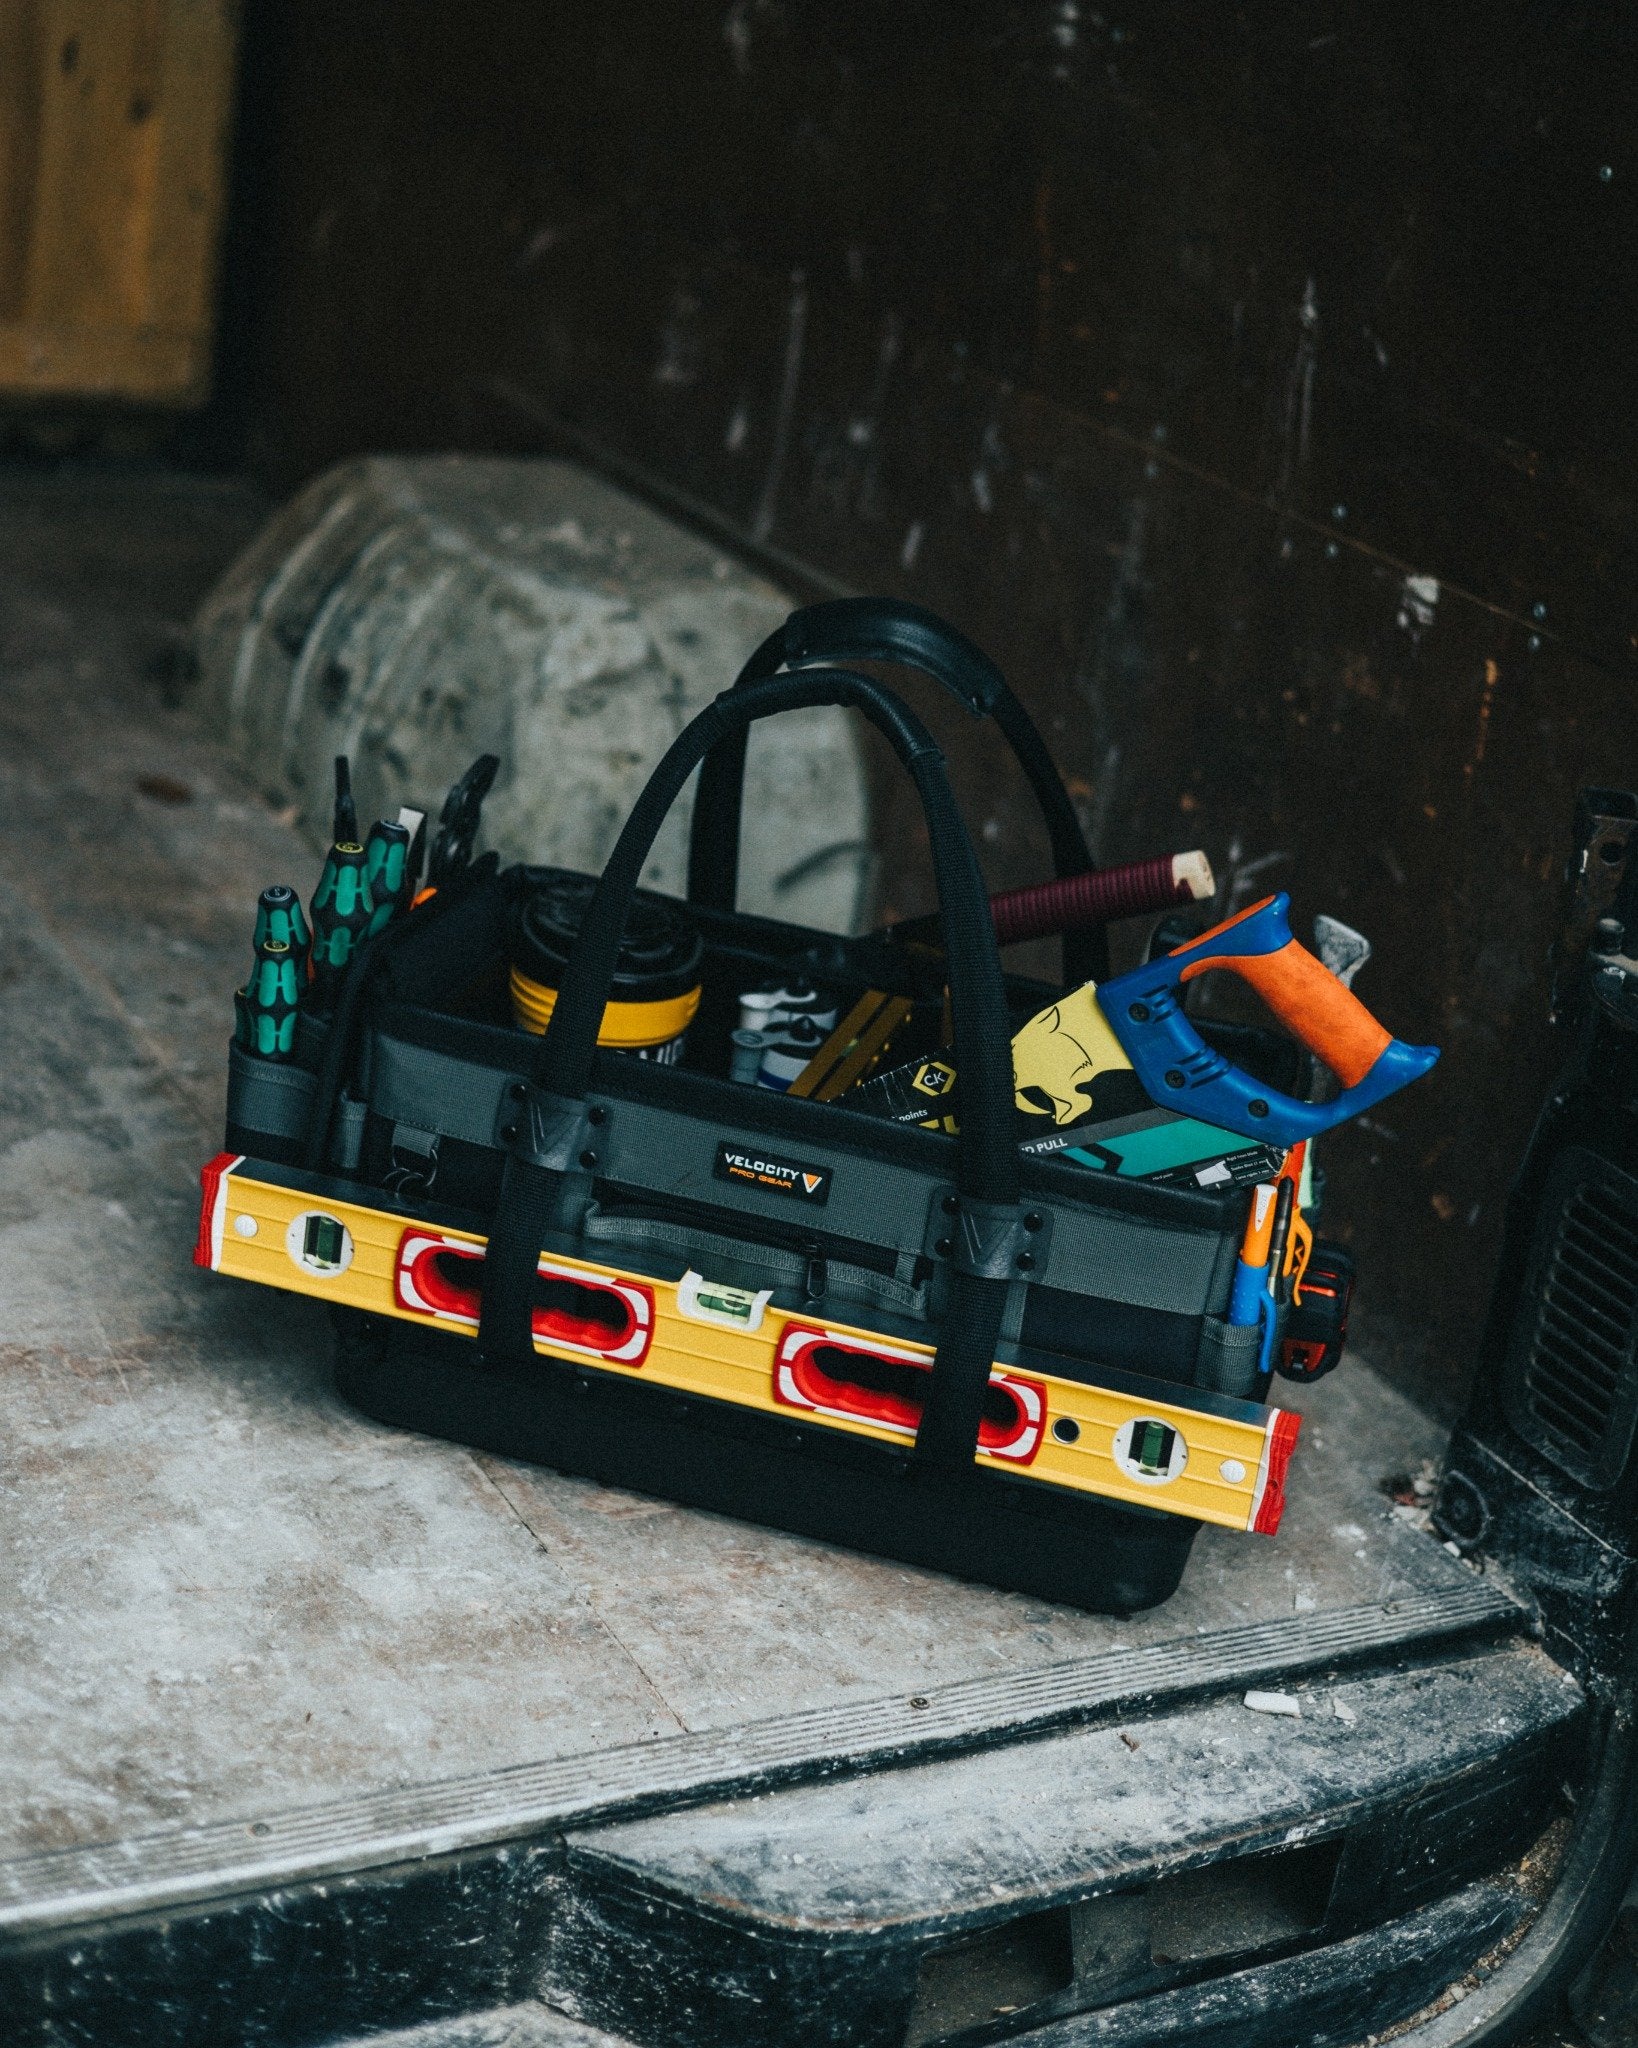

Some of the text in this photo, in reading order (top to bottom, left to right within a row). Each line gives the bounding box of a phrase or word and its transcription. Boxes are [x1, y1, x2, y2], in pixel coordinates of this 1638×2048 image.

[1036, 1138, 1068, 1153] PULL
[725, 1152, 800, 1180] VELOCITY
[729, 1166, 793, 1189] PRO GEAR
